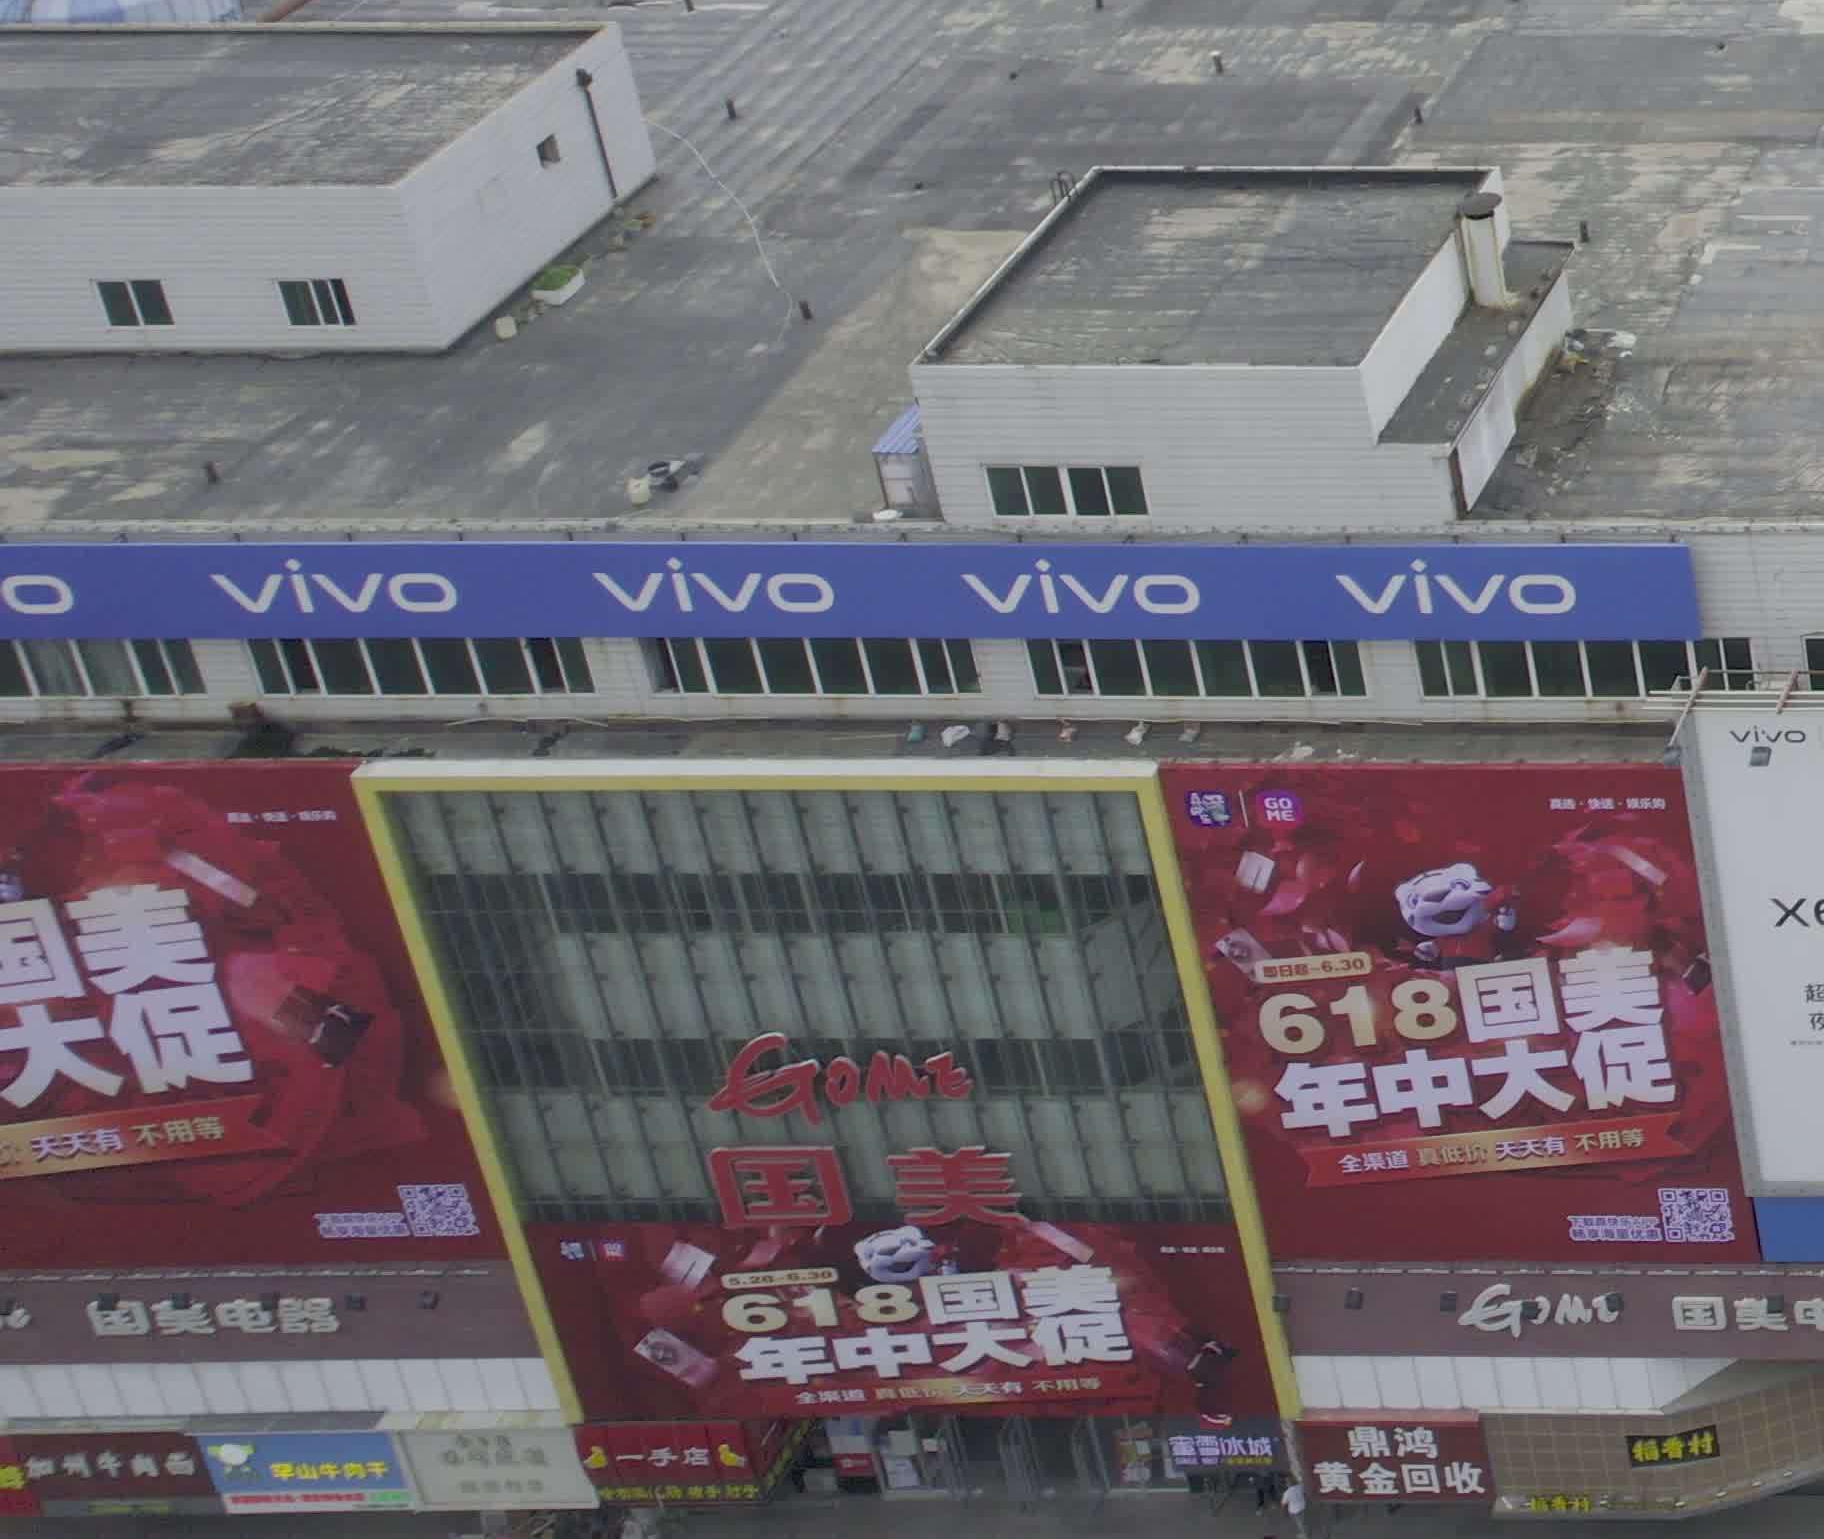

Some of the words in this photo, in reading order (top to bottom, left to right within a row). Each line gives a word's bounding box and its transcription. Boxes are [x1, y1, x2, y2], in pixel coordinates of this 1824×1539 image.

[211, 559, 458, 614] vivo
[593, 557, 835, 613] vivo
[962, 559, 1201, 614] vivo
[1336, 559, 1577, 614] vivo
[1730, 725, 1807, 744] vivo
[1273, 1024, 1676, 1138] 年中大促
[31, 1127, 124, 1161] 天天有
[130, 1116, 224, 1147] 不用等
[1338, 1149, 1409, 1174] 全渠道
[1495, 1137, 1567, 1161] 天天有
[1575, 1128, 1645, 1151] 不用等
[710, 1144, 1025, 1228] 国美
[86, 1297, 340, 1335] 国美电器
[735, 1312, 1133, 1385] 年中大促
[795, 1388, 869, 1405] 全渠道
[951, 1382, 1024, 1398] 天天有
[1033, 1378, 1102, 1392] 不用等
[615, 1446, 710, 1467] 一手店
[1347, 1426, 1439, 1460] 鼎鸿
[1631, 1433, 1716, 1462] 稻香村
[1312, 1461, 1486, 1495] 黄金回收
